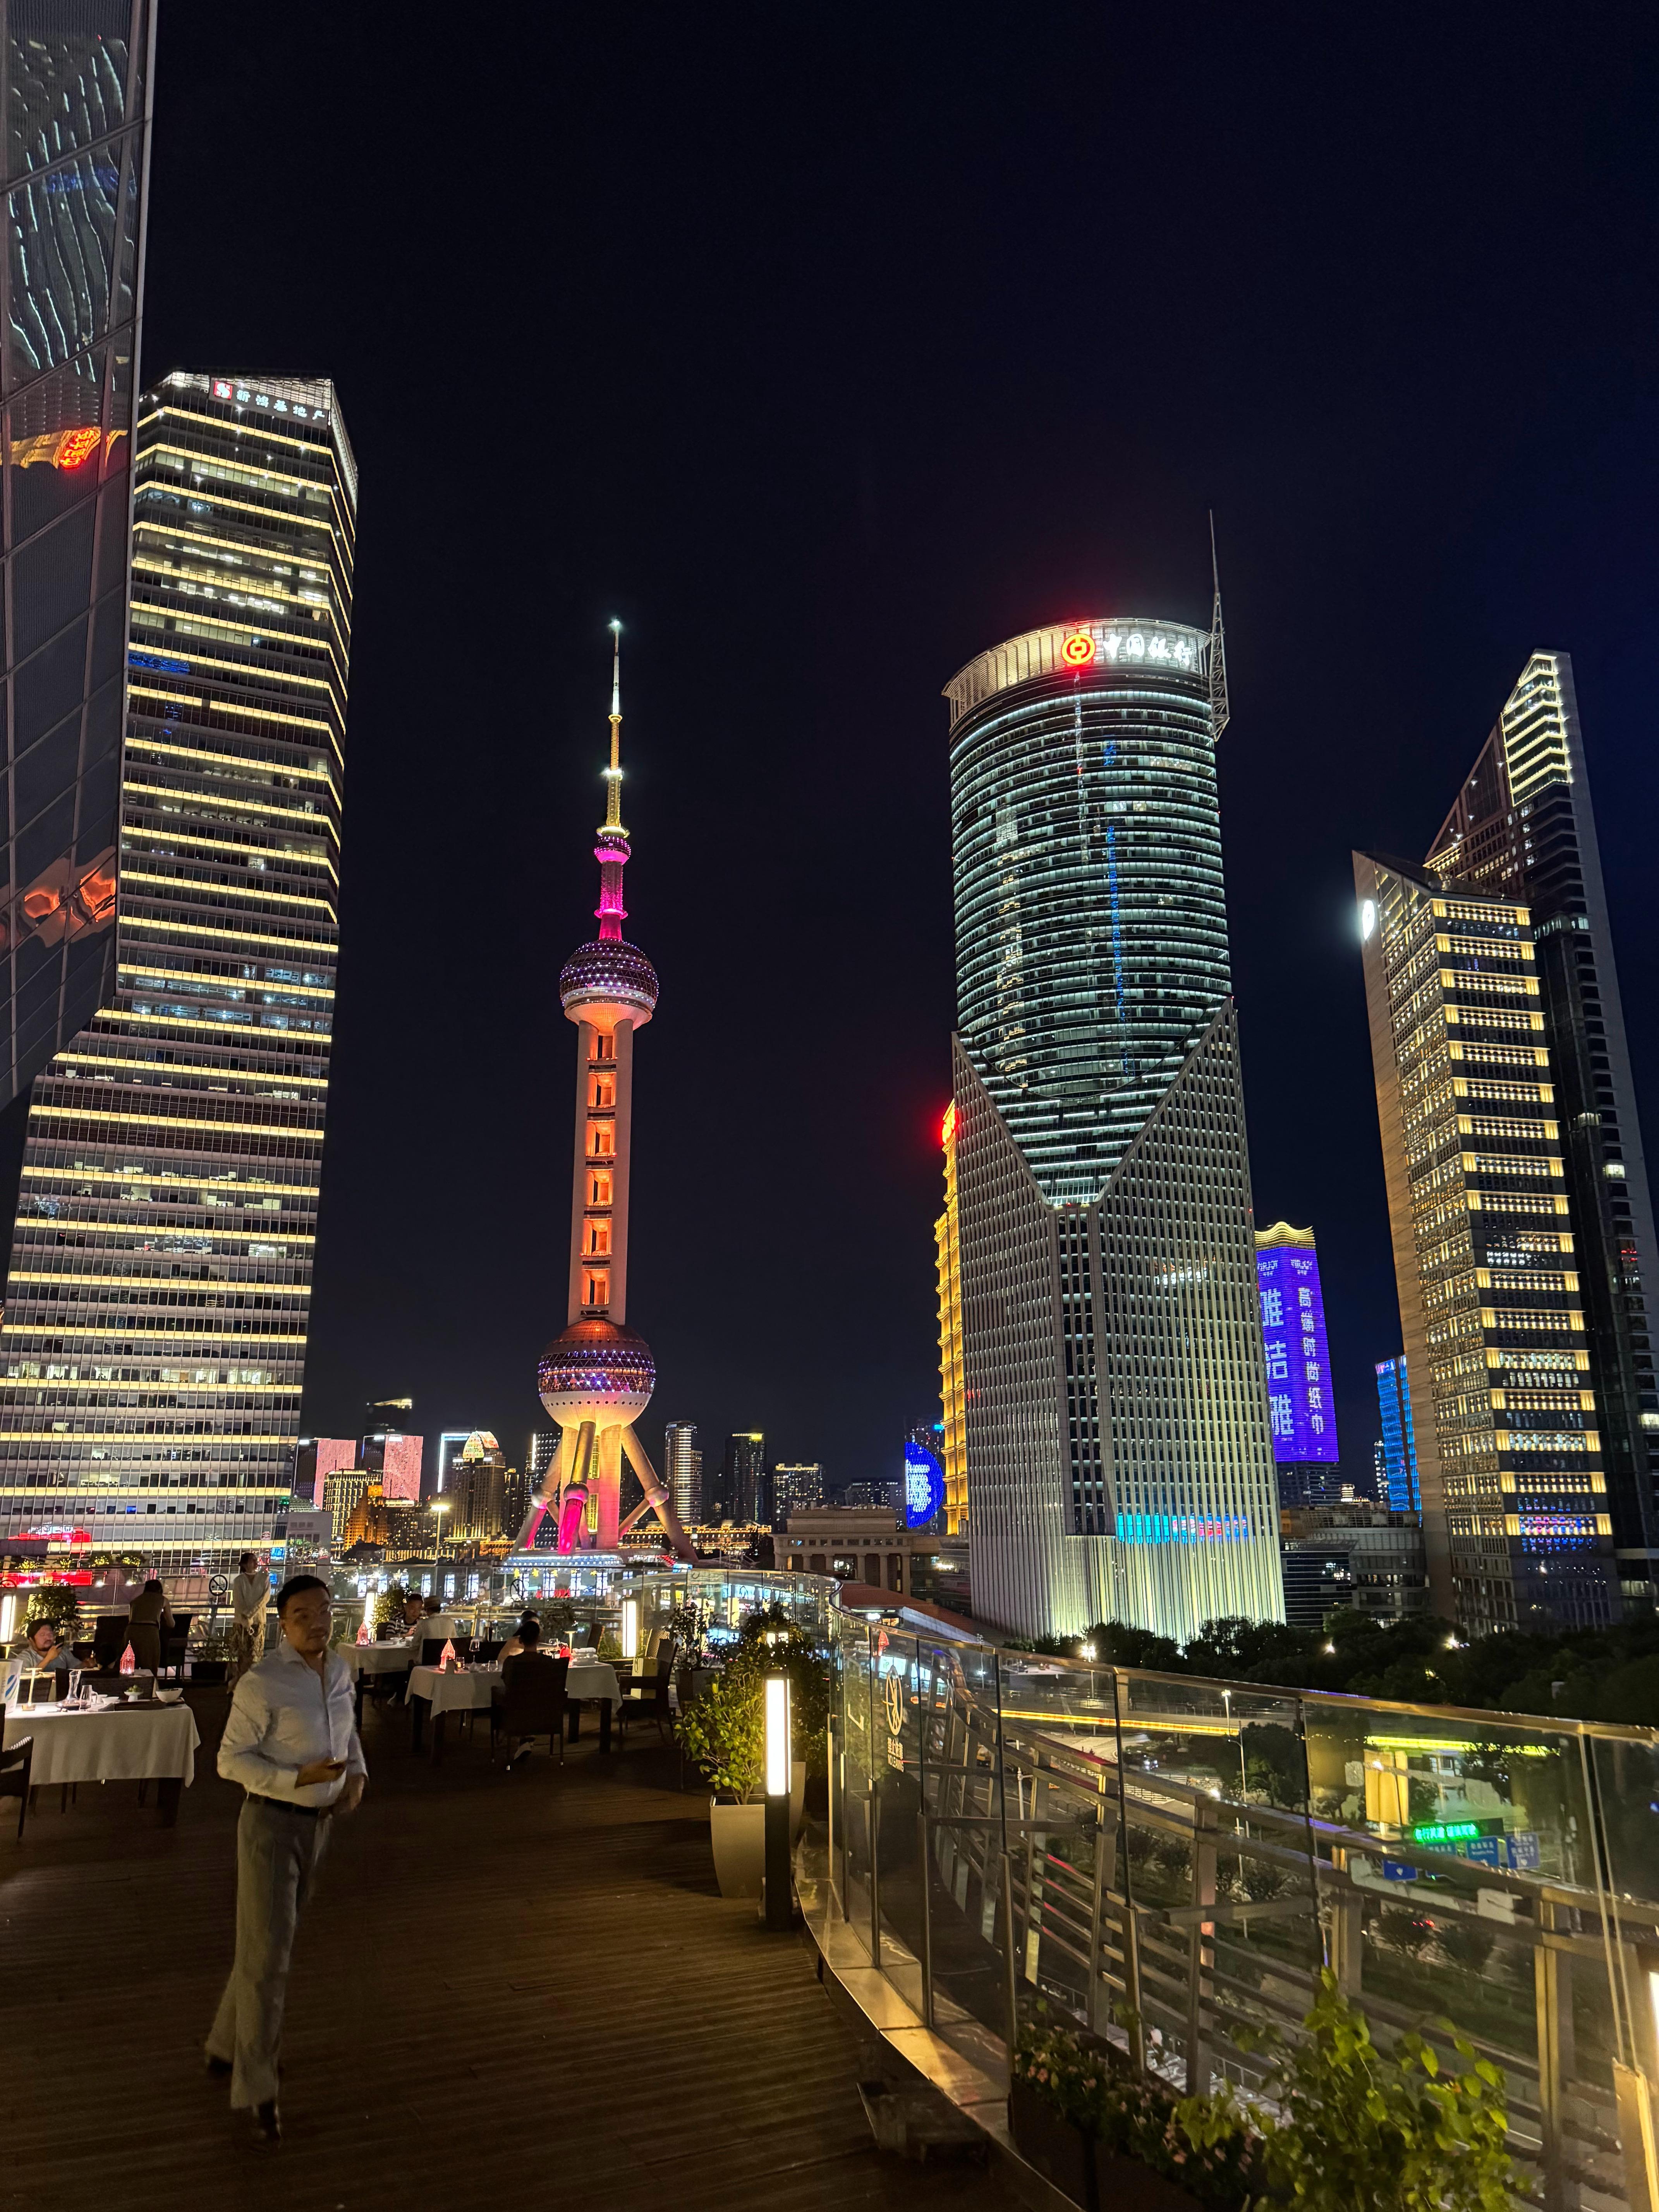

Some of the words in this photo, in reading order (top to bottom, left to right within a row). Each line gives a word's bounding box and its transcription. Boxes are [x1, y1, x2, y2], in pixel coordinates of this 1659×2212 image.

[236, 390, 325, 420] 新鸿基地产
[1103, 633, 1193, 666] 中国银行
[1259, 1288, 1295, 1435] 唯洁雅
[1298, 1288, 1324, 1434] 高端时尚纸巾
